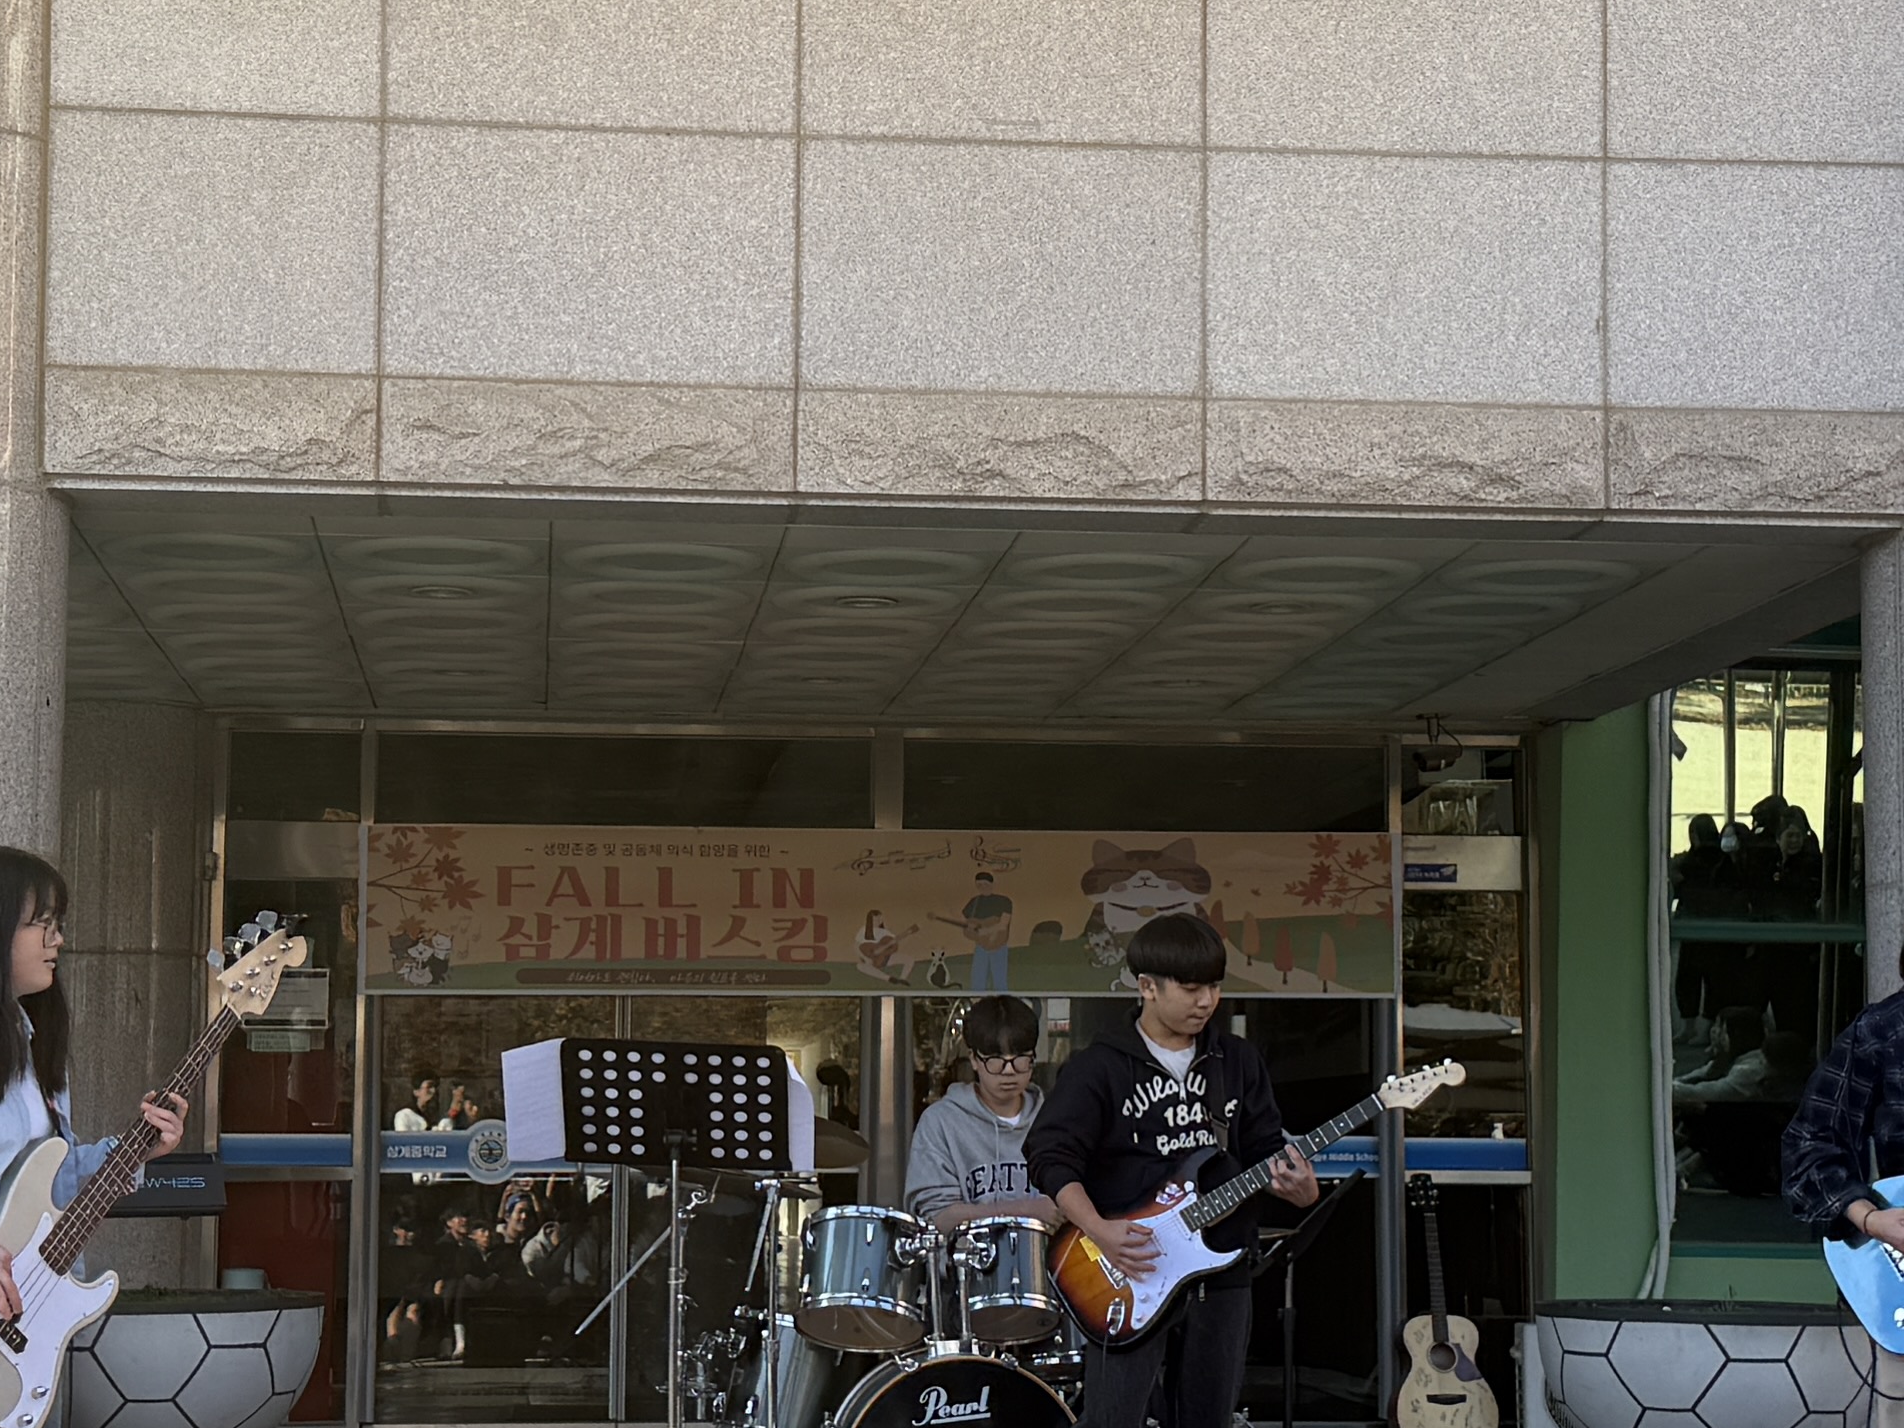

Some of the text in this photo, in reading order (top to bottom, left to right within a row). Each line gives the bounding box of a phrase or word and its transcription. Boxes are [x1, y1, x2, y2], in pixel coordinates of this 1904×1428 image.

[543, 843, 598, 857] 생명존중
[603, 843, 617, 857] 및
[620, 844, 662, 858] 공동체
[666, 844, 694, 858] 의식
[699, 844, 739, 858] 함양을
[744, 844, 771, 859] 위한
[495, 865, 815, 910] FALL IN
[496, 912, 829, 964] 삼계 버스킹
[1163, 1102, 1203, 1128] 184
[386, 1145, 447, 1159] 삼계중학교
[1156, 1131, 1197, 1156] Gold
[912, 1385, 990, 1427] Pearl
